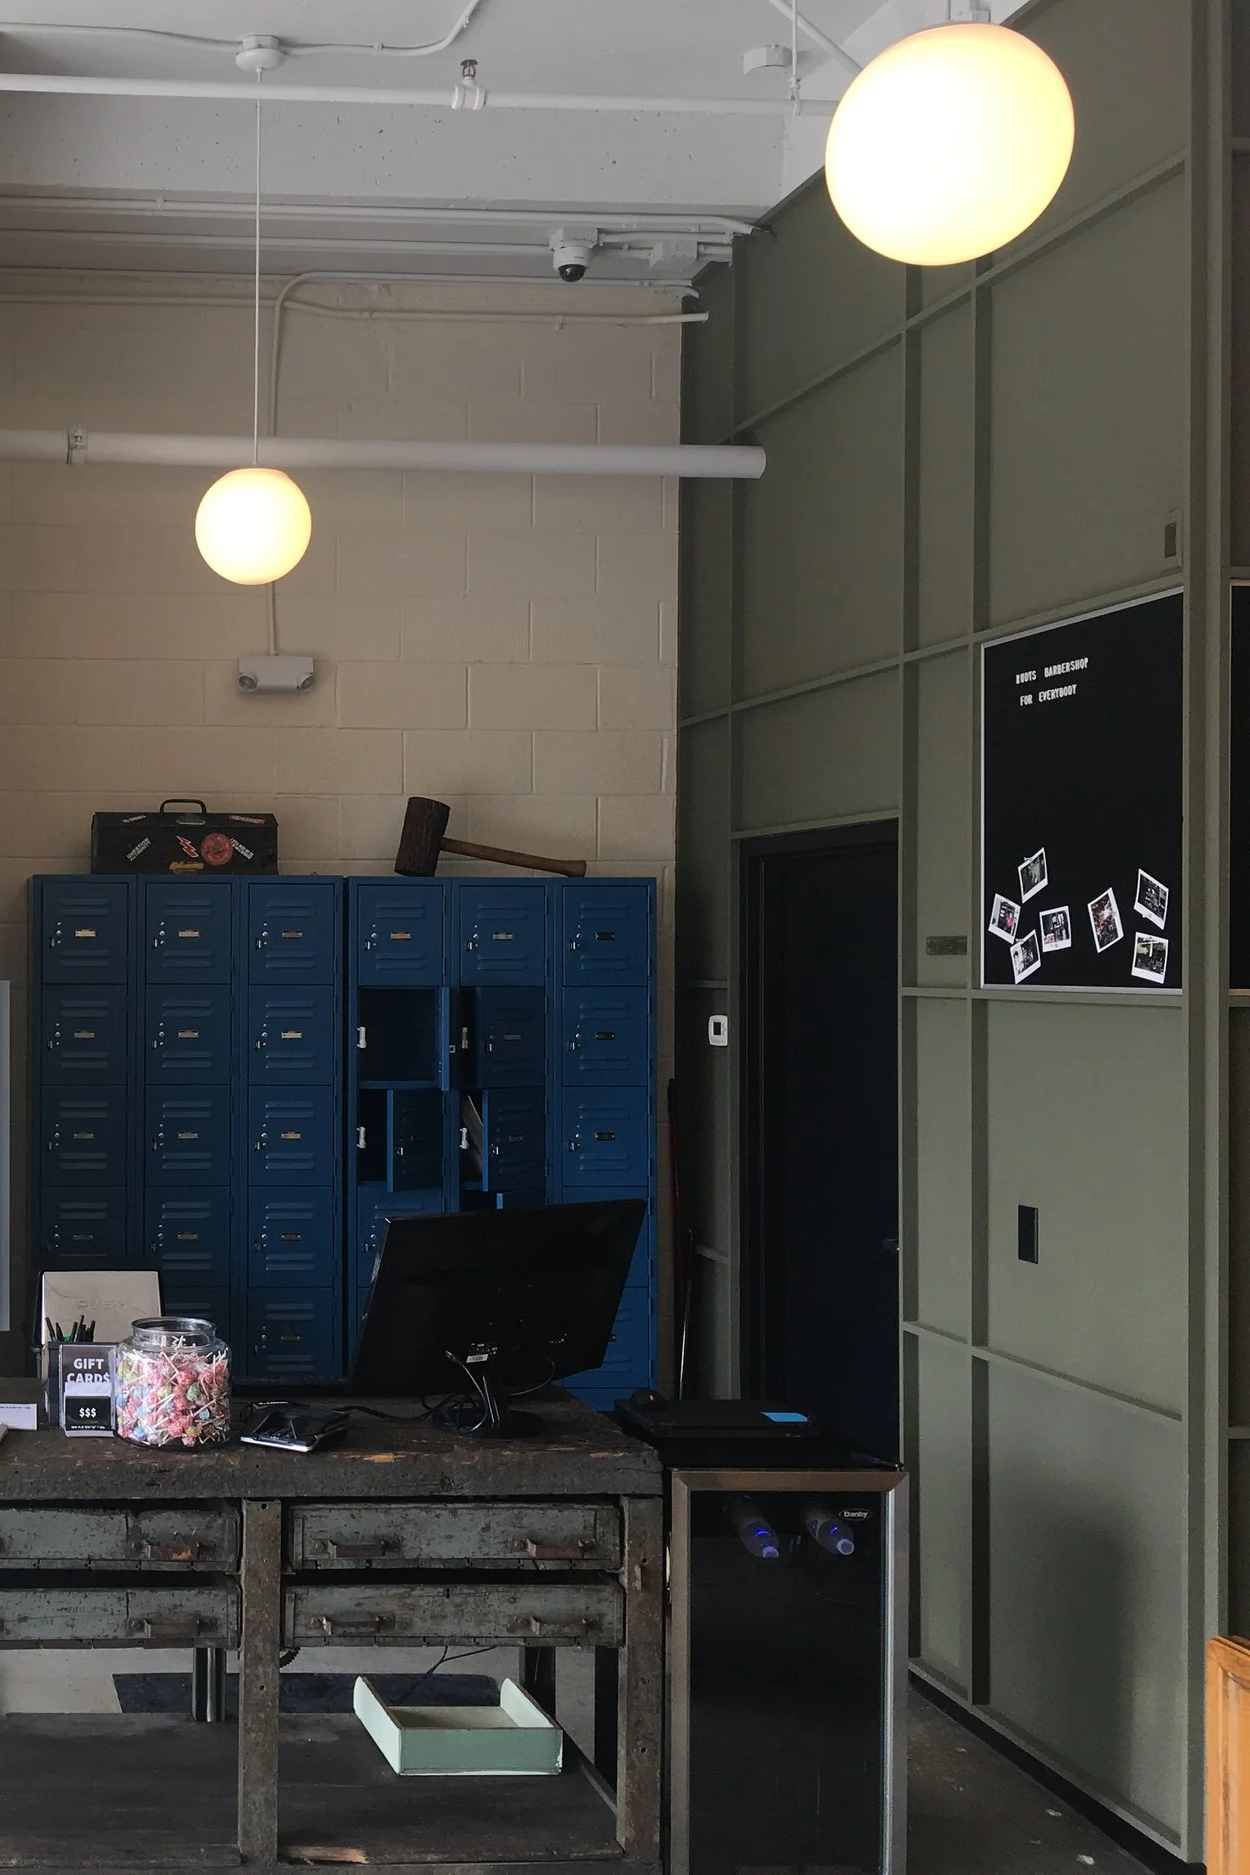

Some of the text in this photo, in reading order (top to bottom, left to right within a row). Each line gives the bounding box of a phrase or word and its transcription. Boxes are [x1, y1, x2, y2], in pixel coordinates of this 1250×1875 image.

[1044, 657, 1089, 678] BARBERSHOP
[1020, 683, 1077, 706] FOR EVERYBODY
[73, 1358, 104, 1370] GIFT
[79, 1407, 97, 1418] $$$
[843, 1511, 869, 1519] Danby
